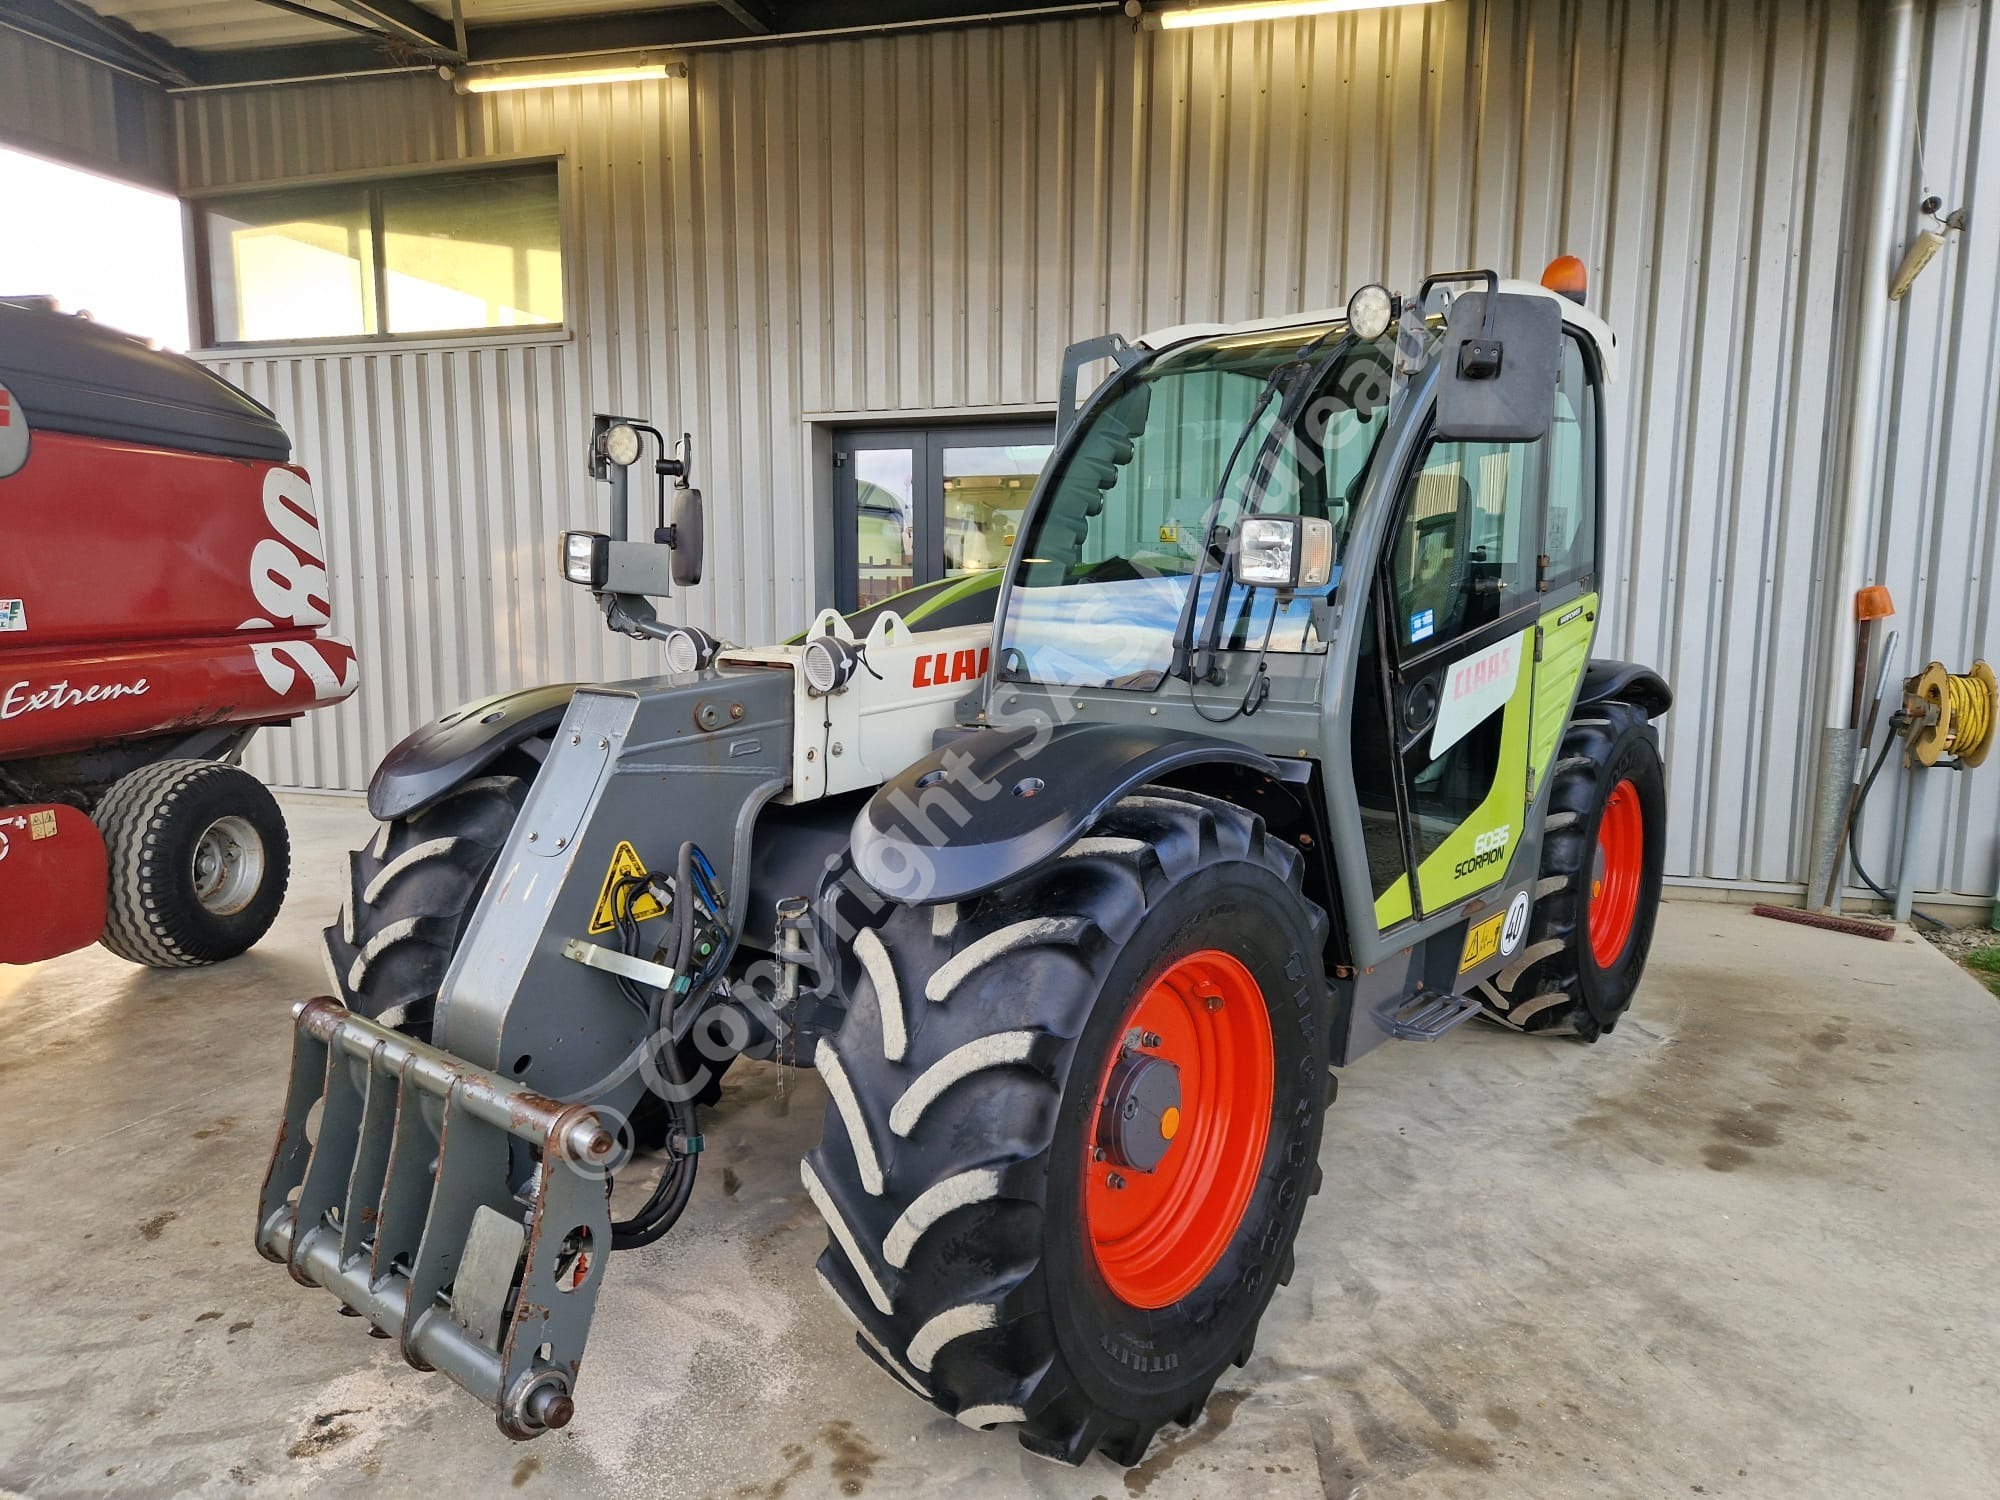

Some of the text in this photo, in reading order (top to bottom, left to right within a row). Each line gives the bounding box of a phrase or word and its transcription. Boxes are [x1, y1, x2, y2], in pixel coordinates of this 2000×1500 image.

[235, 466, 359, 700] 280
[913, 647, 989, 688] CLA
[1454, 647, 1512, 702] CLAAS
[1, 678, 150, 719] Extreme
[1474, 824, 1510, 856] 6035
[1454, 845, 1505, 879] SCORPION
[1505, 902, 1524, 942] 40
